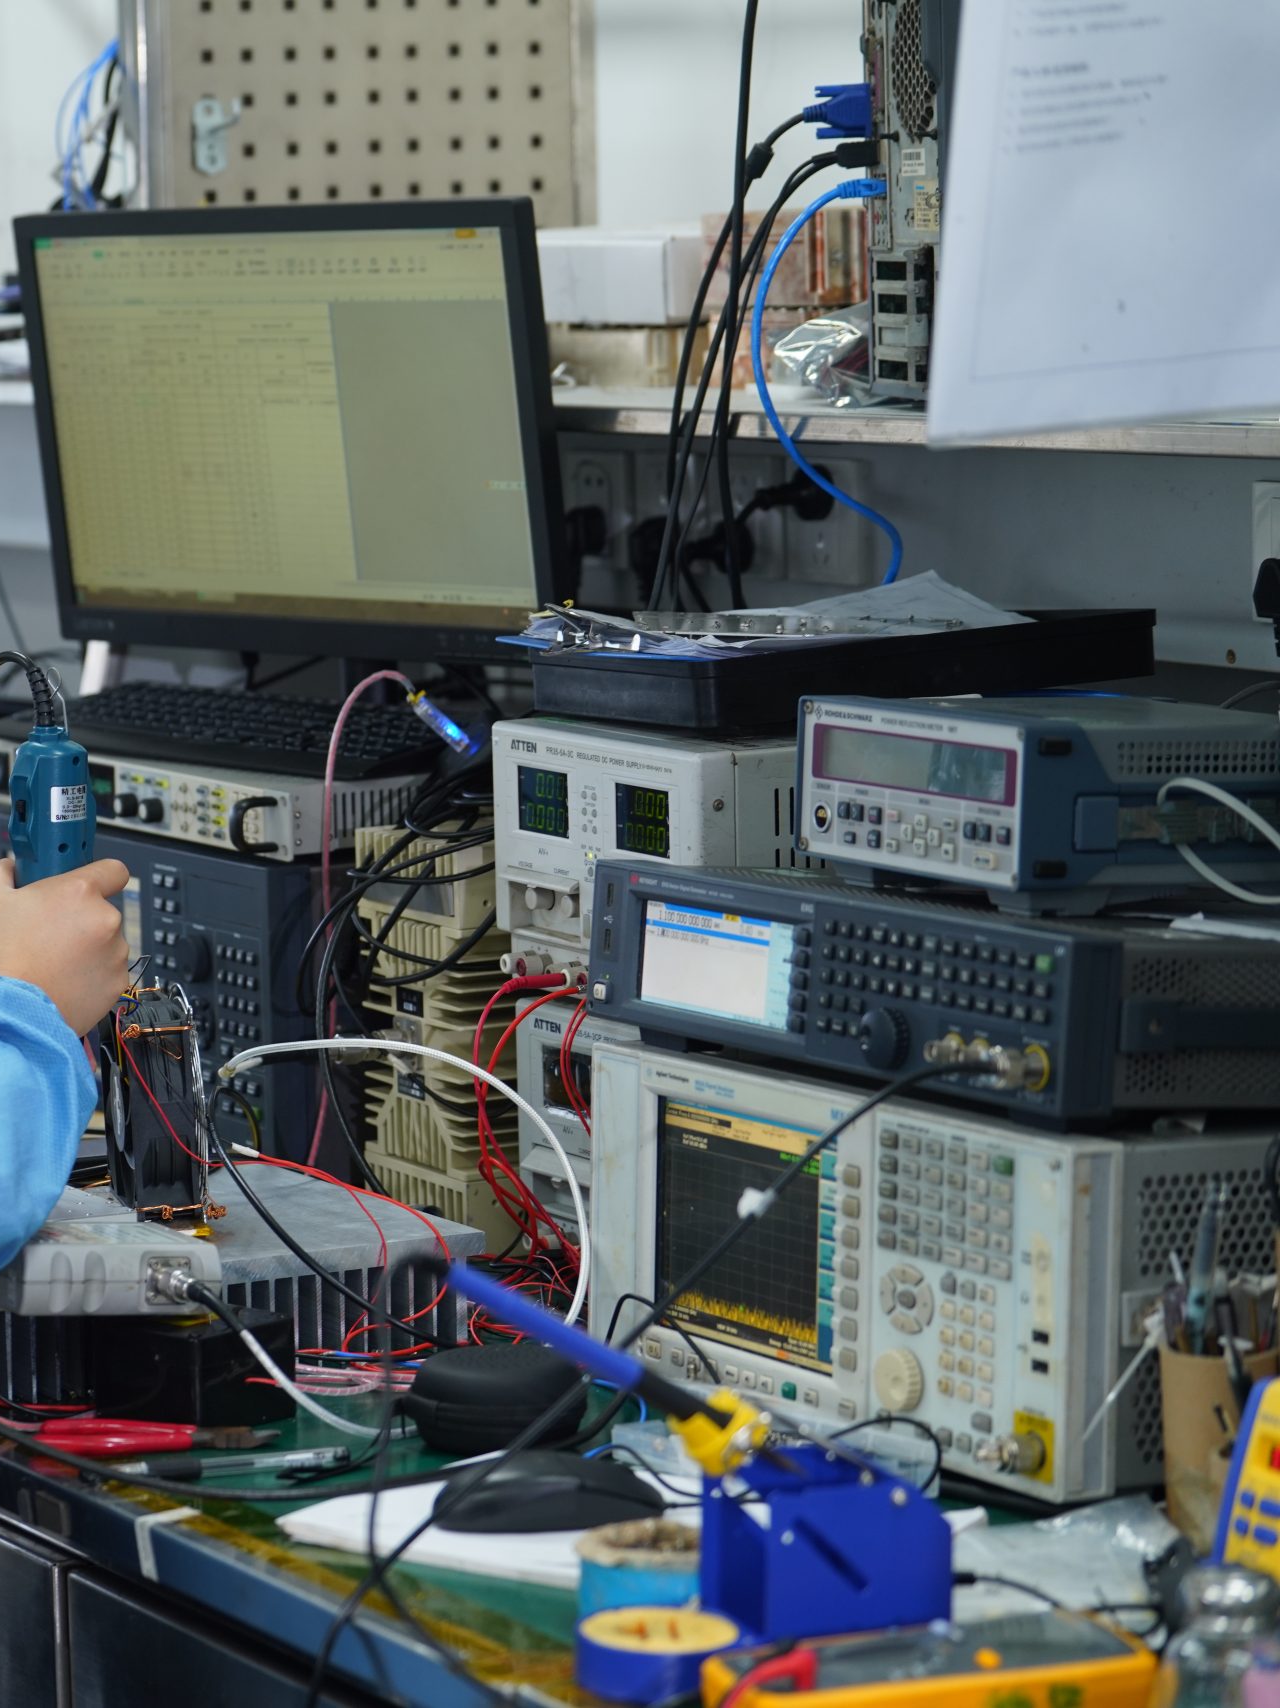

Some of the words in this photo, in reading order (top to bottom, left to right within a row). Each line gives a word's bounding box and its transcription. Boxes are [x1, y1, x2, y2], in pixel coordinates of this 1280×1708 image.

[511, 738, 537, 754] ATTEN
[576, 752, 601, 763] REGULATED
[601, 756, 608, 764] DC
[609, 757, 625, 767] POWER
[626, 760, 641, 770] SUPPLY
[533, 1017, 562, 1034] ATTEN
